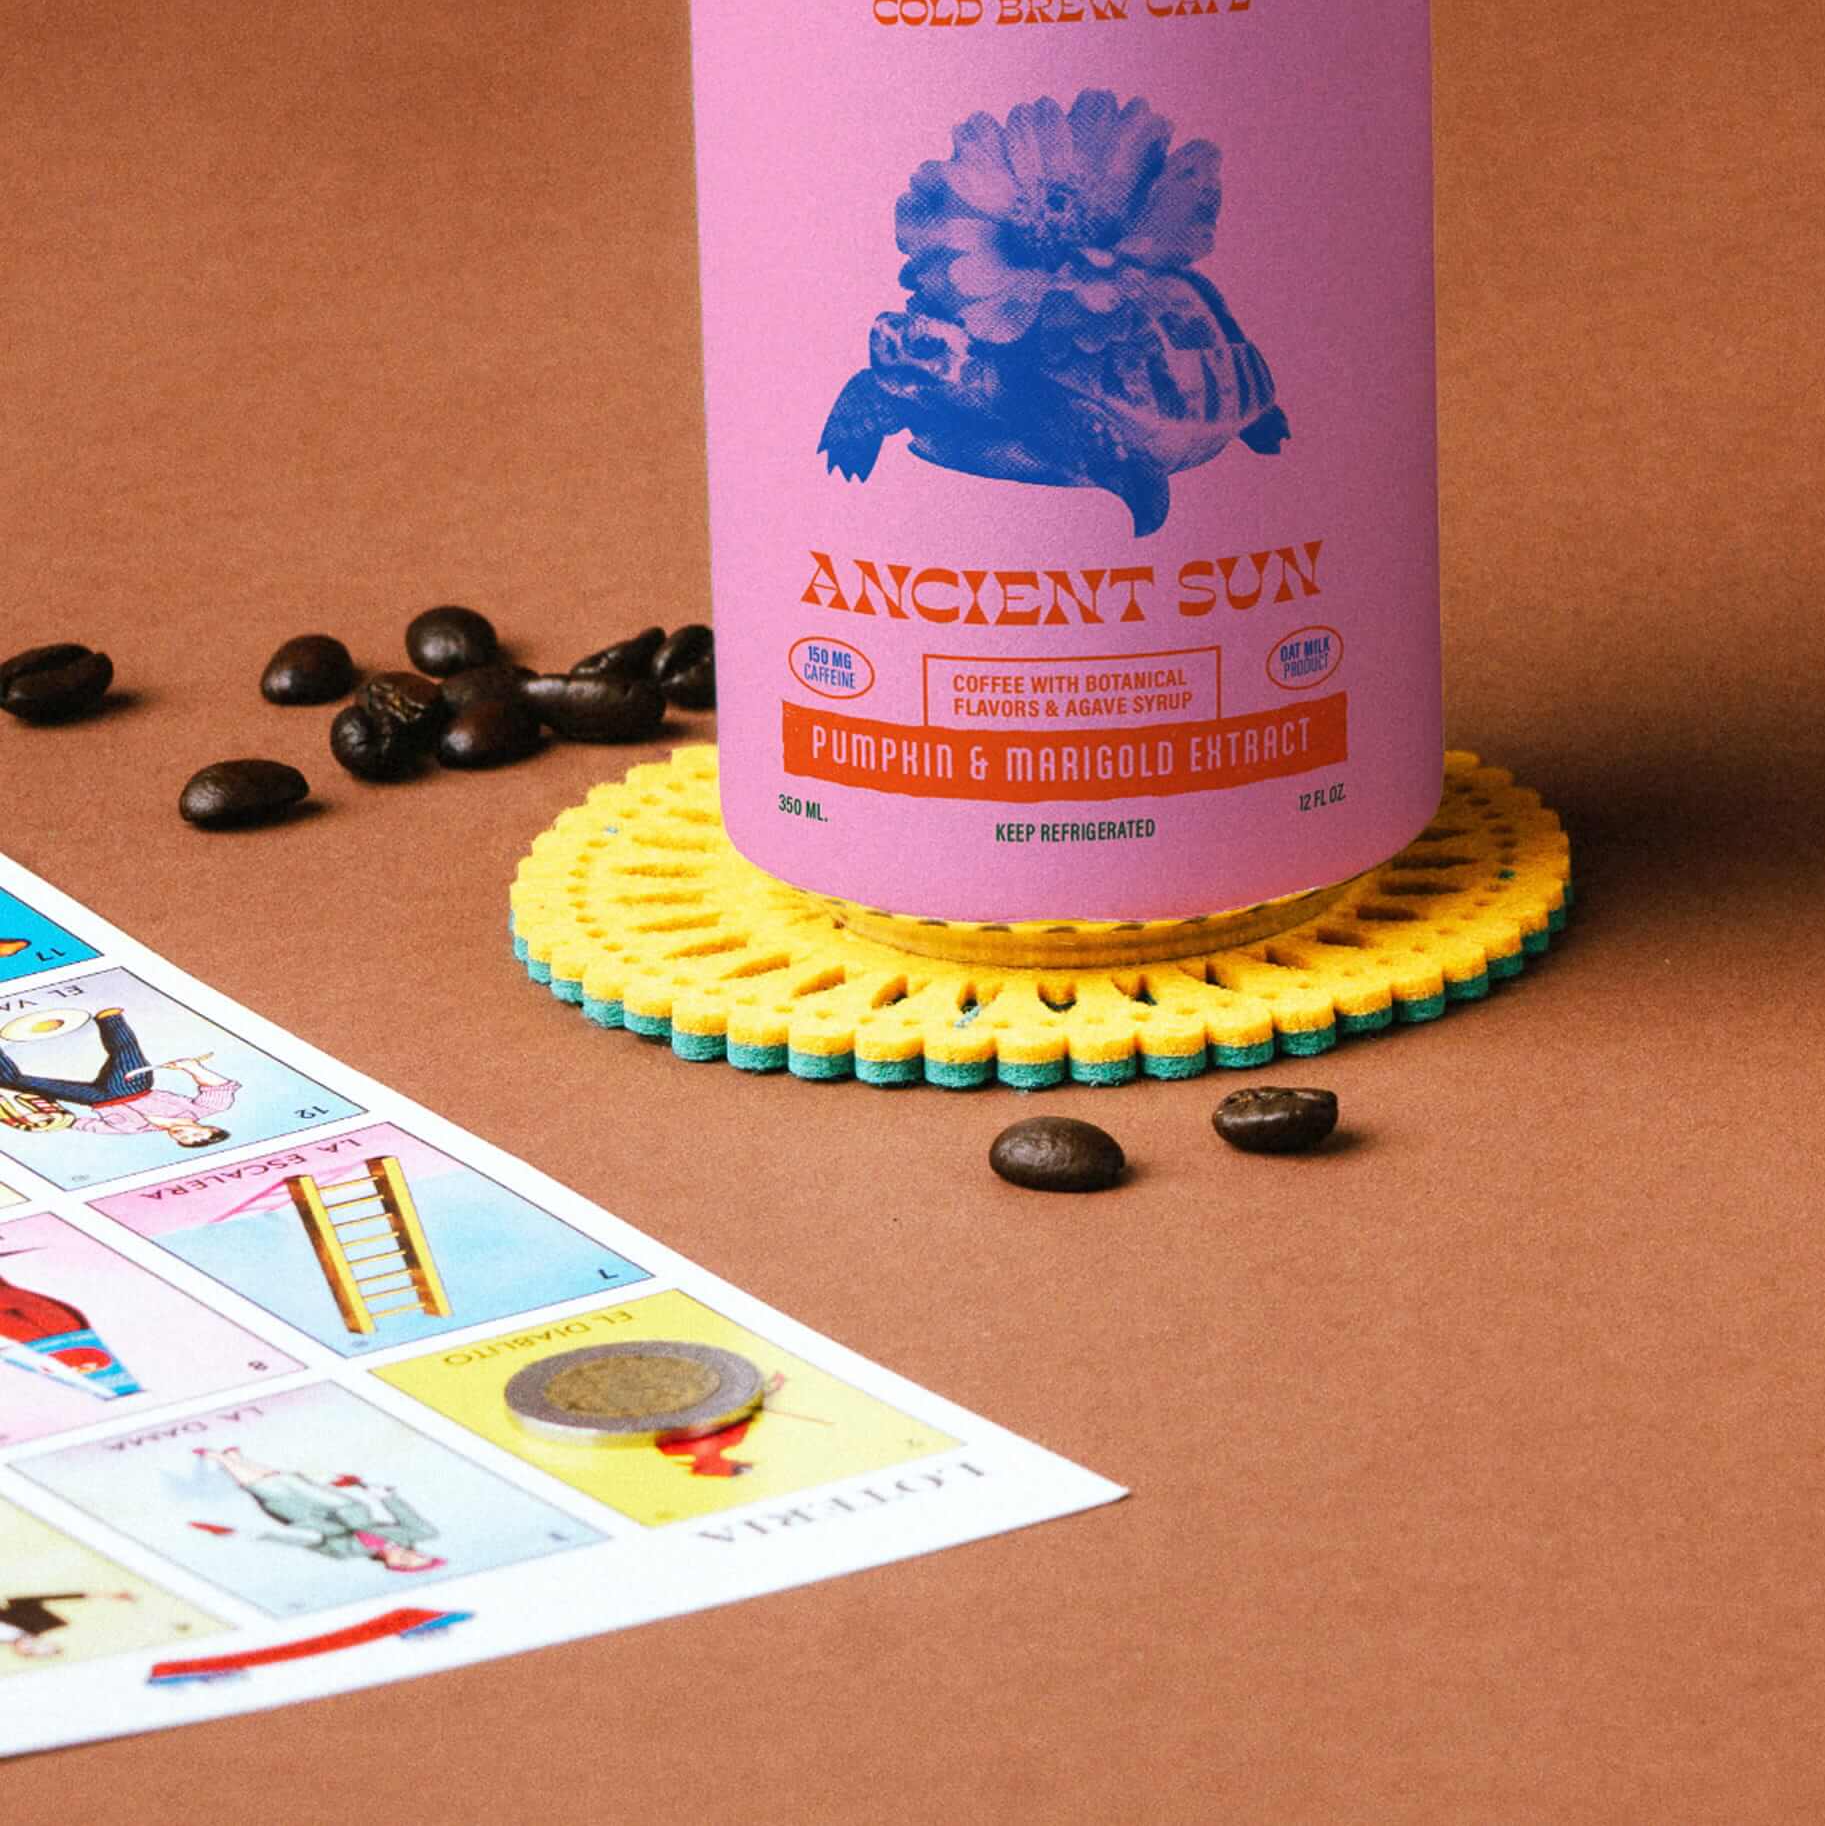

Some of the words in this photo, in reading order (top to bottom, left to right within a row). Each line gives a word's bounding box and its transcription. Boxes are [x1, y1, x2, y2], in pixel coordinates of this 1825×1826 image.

[800, 550, 1155, 625] ANCIENT
[1178, 540, 1324, 616] SUN
[807, 645, 829, 666] 150
[832, 652, 852, 670] MG
[1279, 642, 1301, 663] OAT
[1303, 635, 1331, 657] MILK
[803, 662, 856, 690] CAFFEINE
[1283, 653, 1330, 679] PRODUCT
[952, 673, 1025, 694] COFFEE
[1030, 674, 1079, 694] WITH
[1085, 668, 1187, 693] BOTANICAL
[953, 697, 1039, 718] FLAVORS
[1045, 697, 1058, 718] &
[1065, 696, 1127, 718] AGAVE
[1132, 691, 1193, 714] SYRUP
[811, 725, 953, 780] PUMPKIN
[970, 745, 989, 781] &
[1007, 740, 1173, 782] MARIGOLD
[1190, 717, 1311, 773] EXTRACT
[778, 793, 802, 817] 350
[805, 799, 829, 822] ML.
[1298, 793, 1312, 811] 12
[1315, 788, 1327, 808] FL
[995, 823, 1036, 842] KEEP
[1040, 819, 1157, 842] REFRIGERATED
[48, 983, 85, 998] EL
[294, 1104, 330, 1120] 12
[315, 1137, 362, 1154] LA
[140, 1153, 308, 1201] ESCALERA
[597, 1268, 620, 1280] 7
[596, 1310, 634, 1324] EL
[443, 1322, 592, 1367] DIABLITO
[229, 1404, 266, 1421] LA
[698, 1460, 989, 1545] LOTERIA
